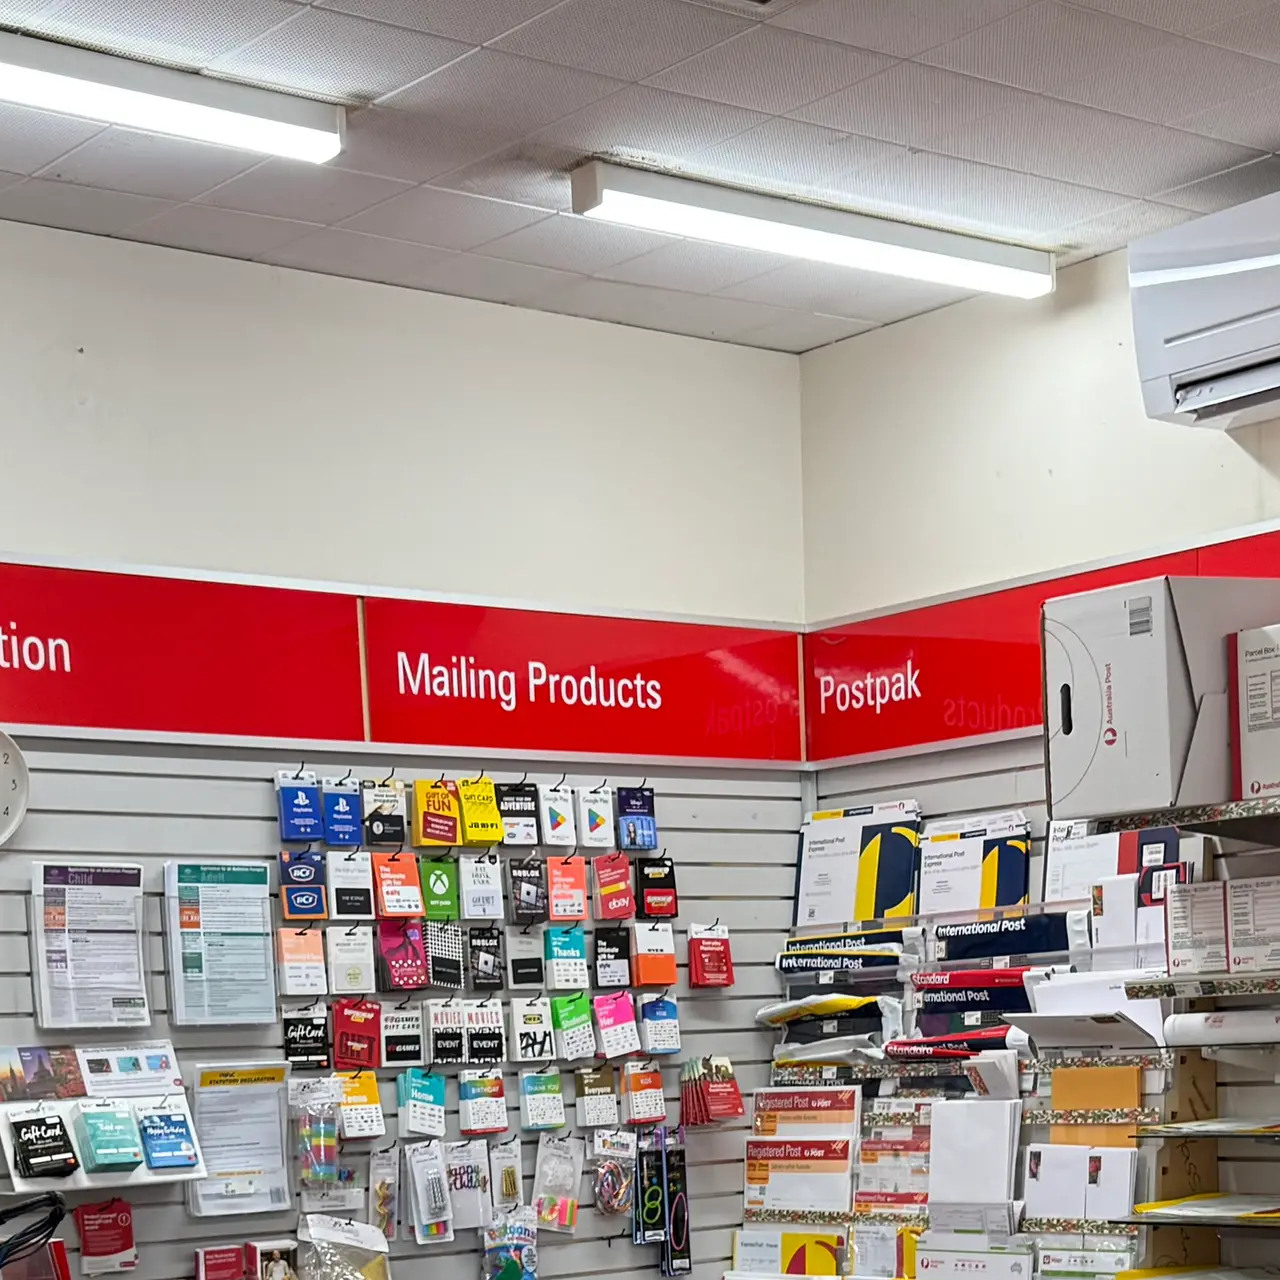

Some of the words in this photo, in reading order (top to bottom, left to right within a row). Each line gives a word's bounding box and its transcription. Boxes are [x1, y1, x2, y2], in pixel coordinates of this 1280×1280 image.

[1105, 662, 1113, 683] Post
[396, 651, 515, 712] Mailing
[527, 661, 662, 712] Products
[818, 659, 922, 715] Postpak
[1105, 684, 1114, 725] Australia
[3, 753, 10, 765] 2
[11, 779, 17, 791] 3
[3, 806, 10, 817] 4
[426, 800, 452, 812] FUN
[501, 801, 535, 811] ADVENTURE
[808, 838, 835, 846] International
[68, 872, 94, 885] Child
[609, 897, 629, 909] ebay
[934, 920, 999, 938] International
[1002, 919, 1026, 931] Post
[553, 948, 579, 957] Thanks
[911, 974, 950, 985] Standard
[967, 990, 990, 1002] Post
[473, 1040, 498, 1048] EVENT
[411, 1090, 434, 1101] Home
[585, 1087, 610, 1095] Everyone
[21, 1125, 40, 1141] Gift
[41, 1125, 62, 1137] Card
[748, 1145, 784, 1159] Registered
[785, 1146, 801, 1157] Post
